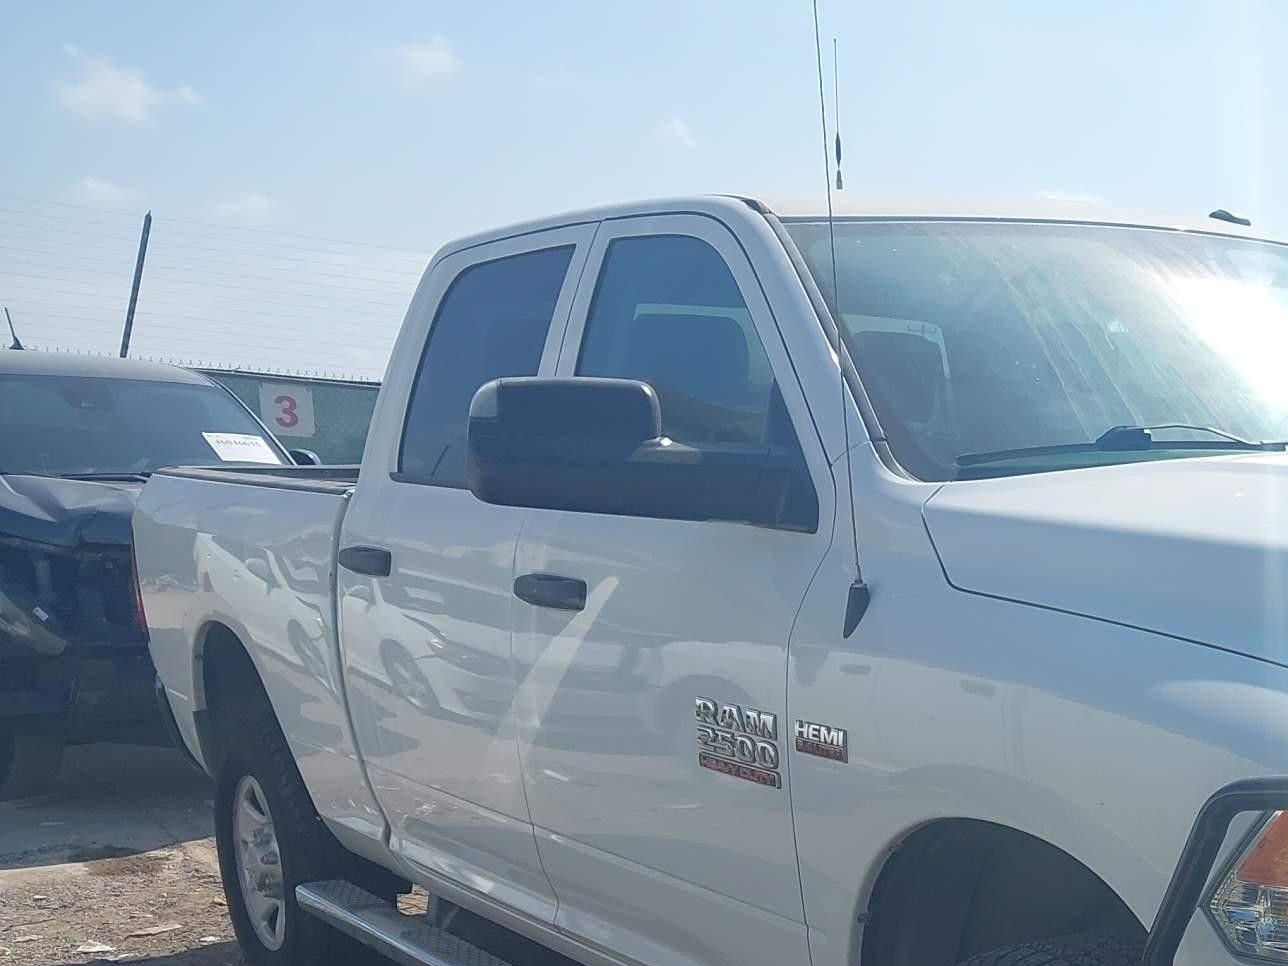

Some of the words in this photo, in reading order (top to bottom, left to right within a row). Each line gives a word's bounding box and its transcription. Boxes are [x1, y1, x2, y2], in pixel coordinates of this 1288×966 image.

[274, 395, 298, 428] 3
[696, 696, 778, 741] RAM
[794, 720, 845, 747] HEMI
[697, 724, 780, 769] 2500
